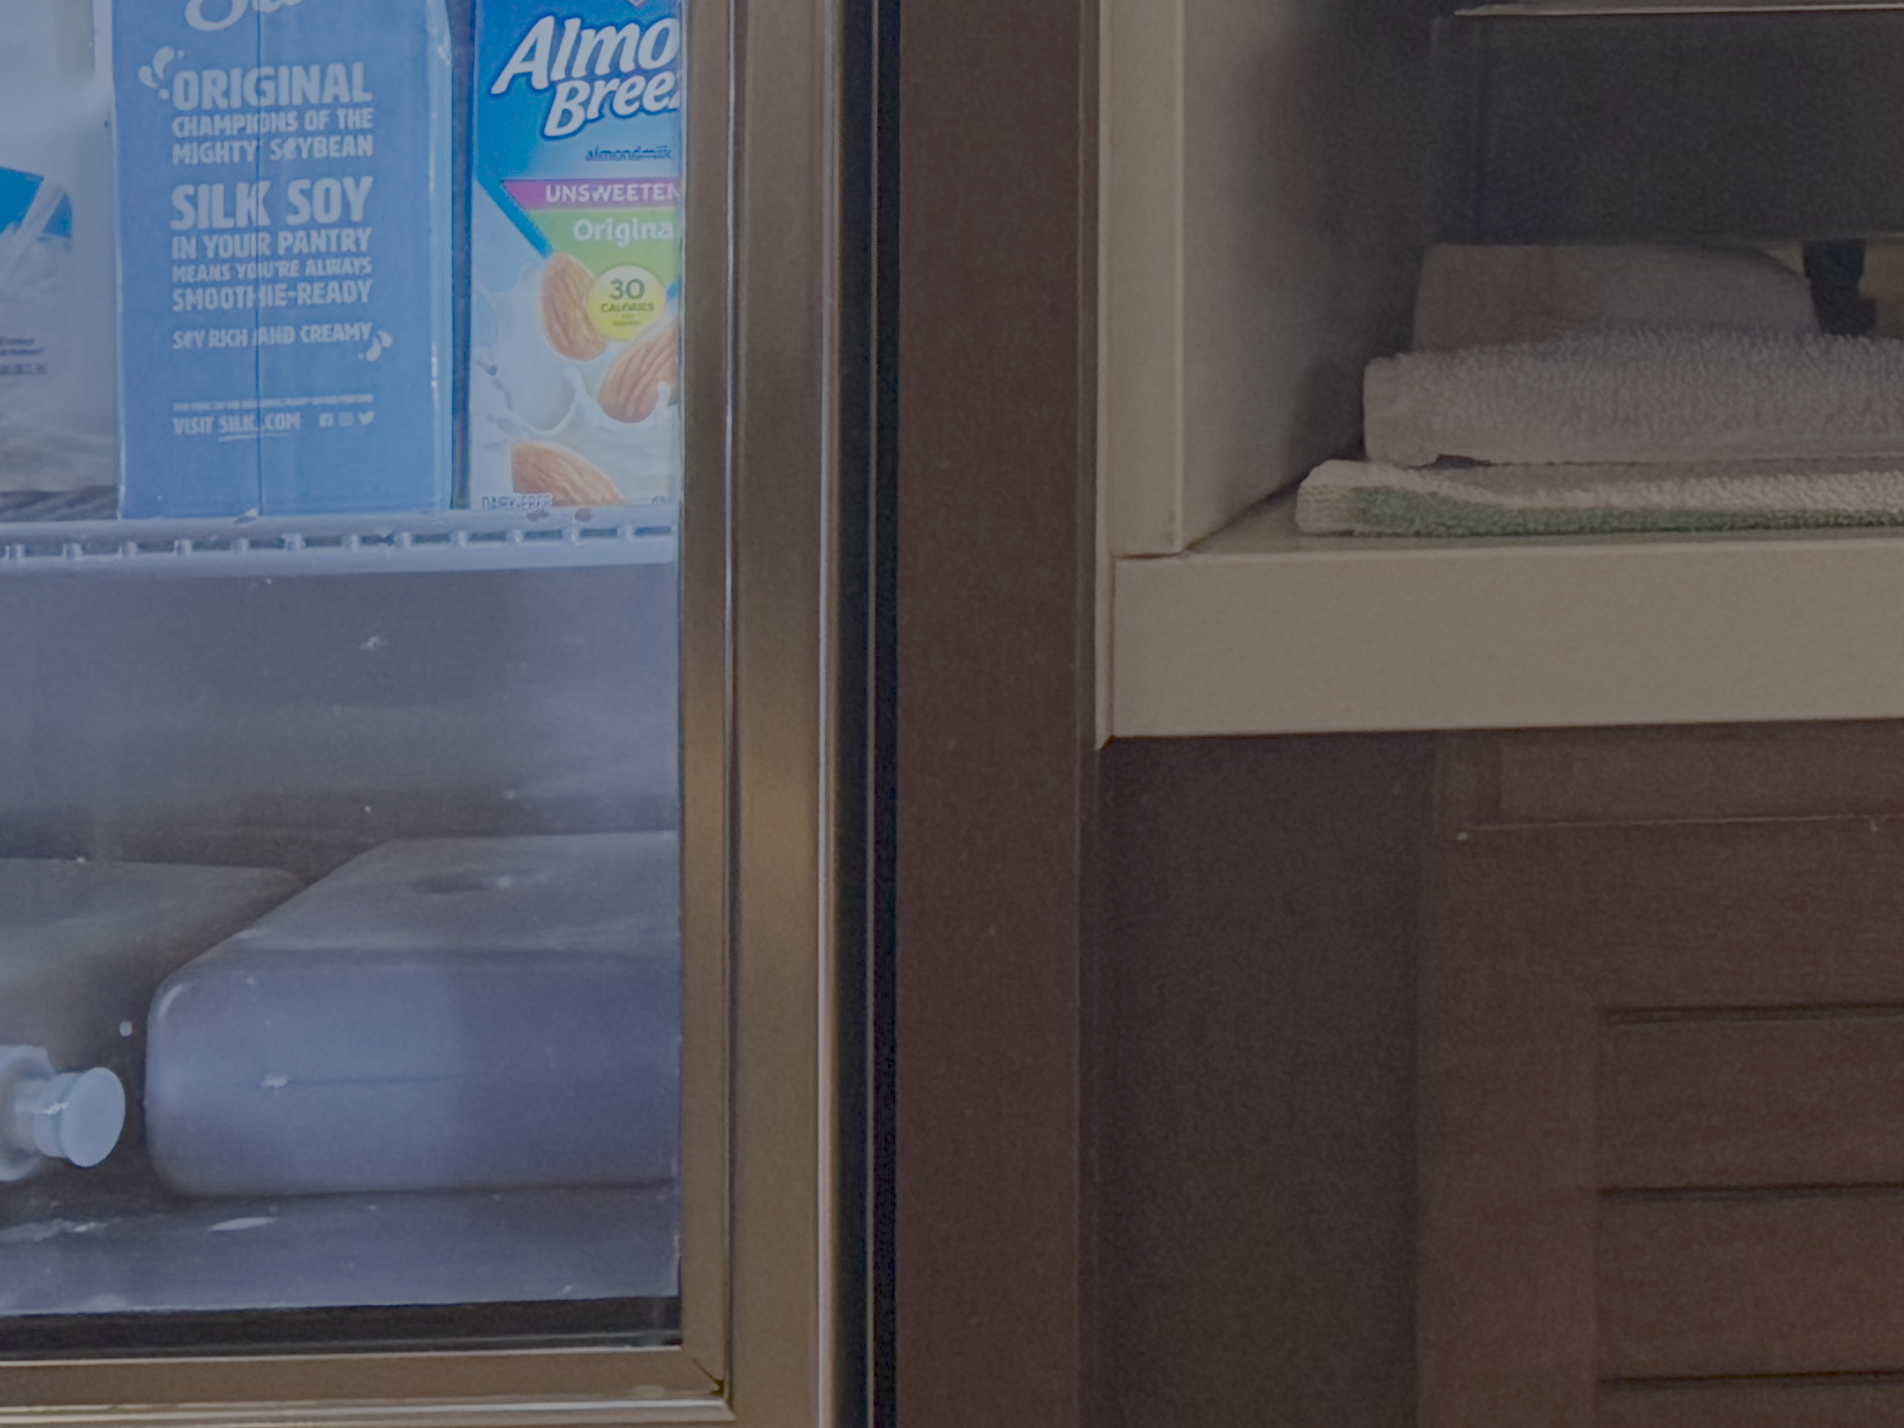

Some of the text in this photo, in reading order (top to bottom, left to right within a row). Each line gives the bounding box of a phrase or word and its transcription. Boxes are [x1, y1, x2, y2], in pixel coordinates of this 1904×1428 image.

[490, 14, 681, 95] Almo
[172, 61, 374, 112] ORIGINAL
[543, 70, 681, 137] Bree
[172, 107, 375, 138] CHAMPIONS OF THE
[172, 134, 374, 166] MIGHTY SOYBEAN
[170, 175, 375, 231] SILK SOY
[545, 182, 681, 204] UNSWEETEN
[171, 227, 373, 261] IN YOUR PANTRY
[572, 216, 676, 248] Origina
[171, 262, 232, 284] MEANS
[304, 256, 373, 278] ALWAYS
[172, 278, 374, 312] SMOOTHIE-READY
[609, 277, 646, 301] 30
[172, 321, 374, 350] SOY RICH AND CREAMY
[172, 415, 215, 436] VISIT
